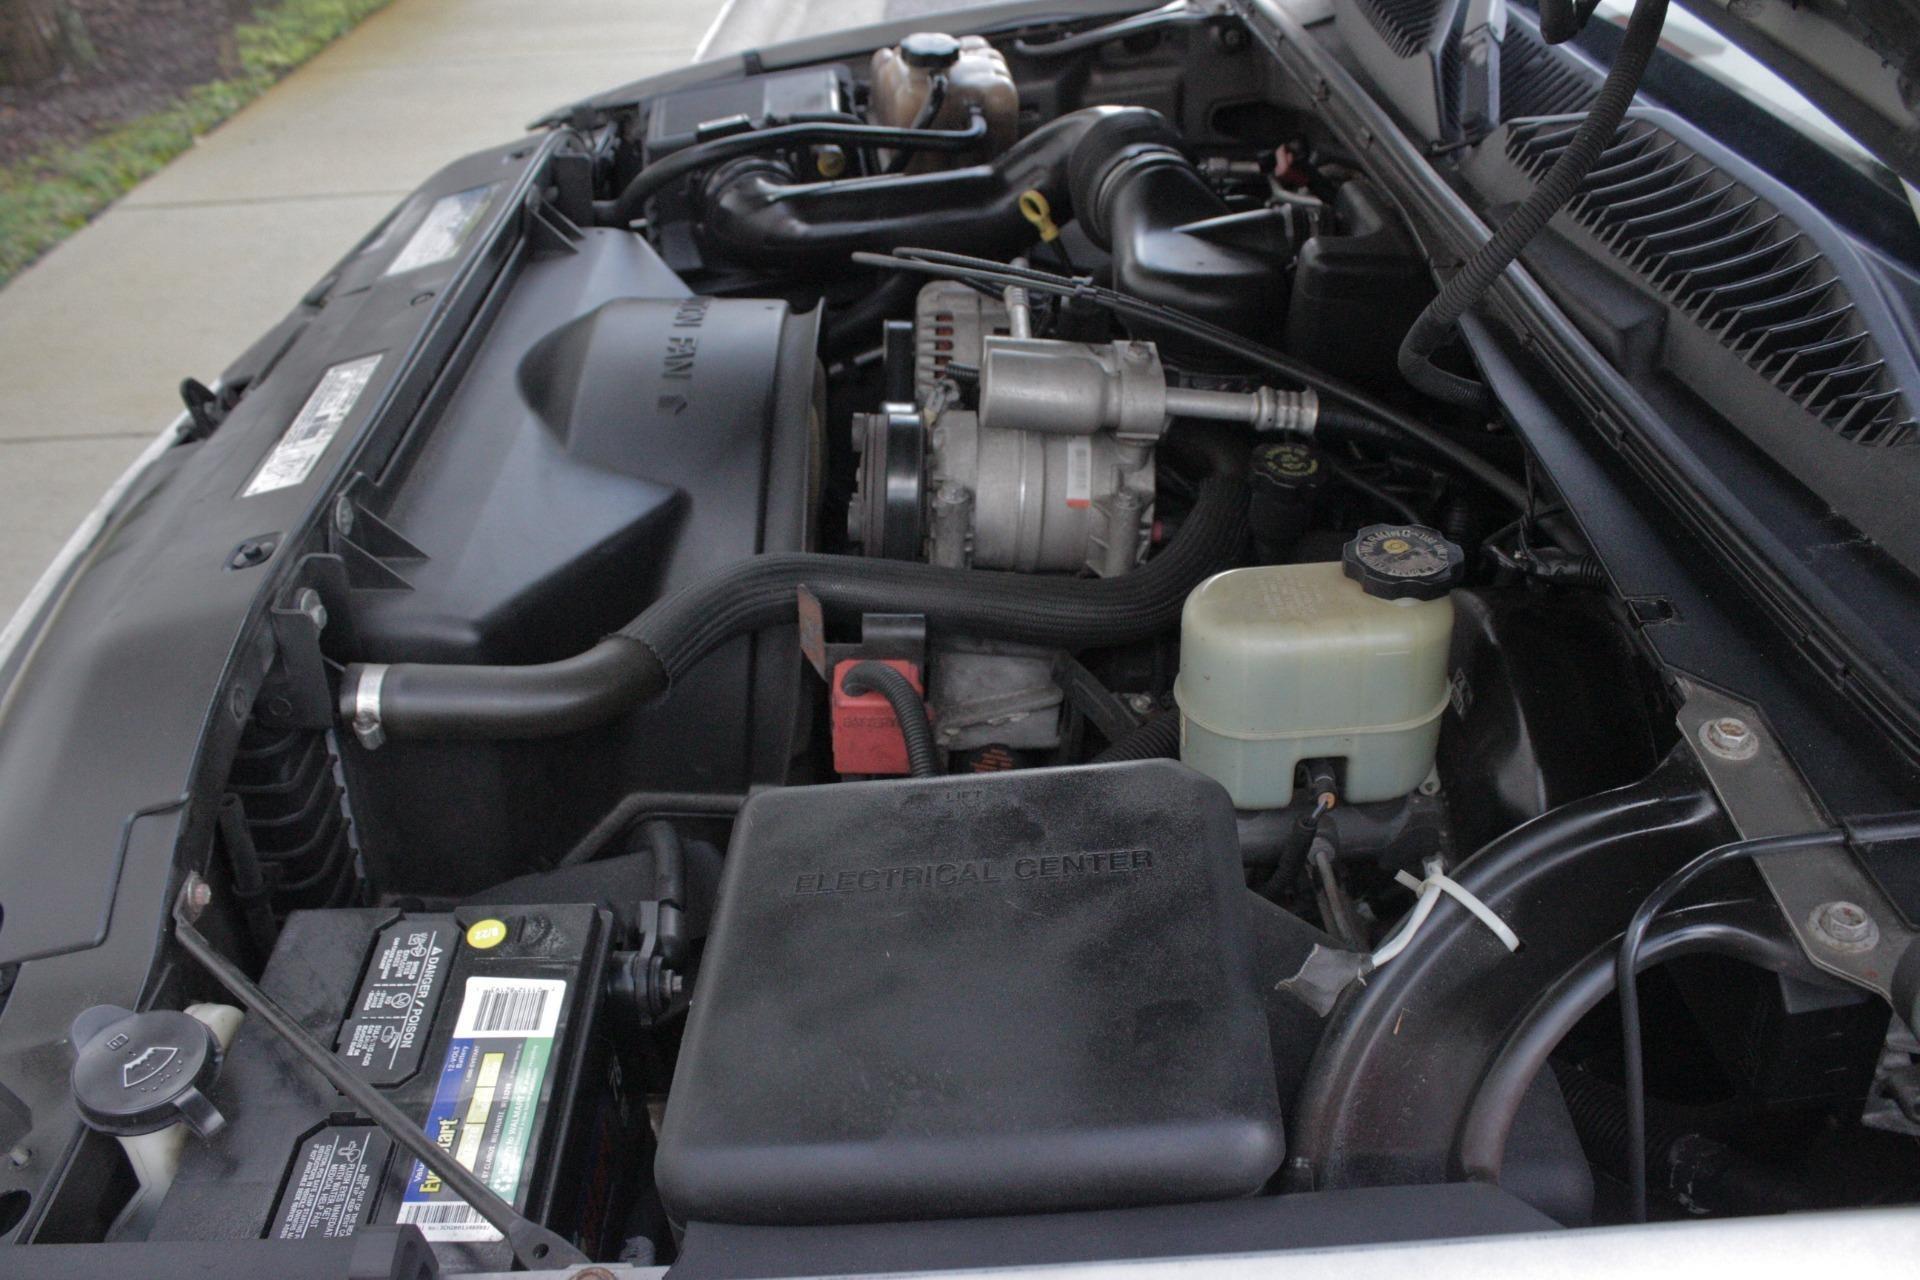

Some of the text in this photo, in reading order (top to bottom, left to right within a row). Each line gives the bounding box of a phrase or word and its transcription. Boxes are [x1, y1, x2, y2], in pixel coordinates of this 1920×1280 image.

[662, 337, 697, 379] FAN
[795, 847, 1154, 896] ELECTRICAL CENTER
[417, 957, 438, 997] DANGER
[400, 1008, 422, 1047] POISON
[455, 1045, 469, 1068] Battery
[508, 1095, 525, 1134] WALMART
[335, 1163, 346, 1179] WITH
[413, 1162, 425, 1181] Valu
[419, 1118, 457, 1192] Evtart
[309, 1163, 338, 1227] MEDICAL HELP FAST
[321, 1207, 331, 1220] GET
[323, 1163, 355, 1237] FLUSH EYES IMMEDIAT
[346, 1198, 356, 1212] KEEP
[356, 1190, 365, 1201] OUT
